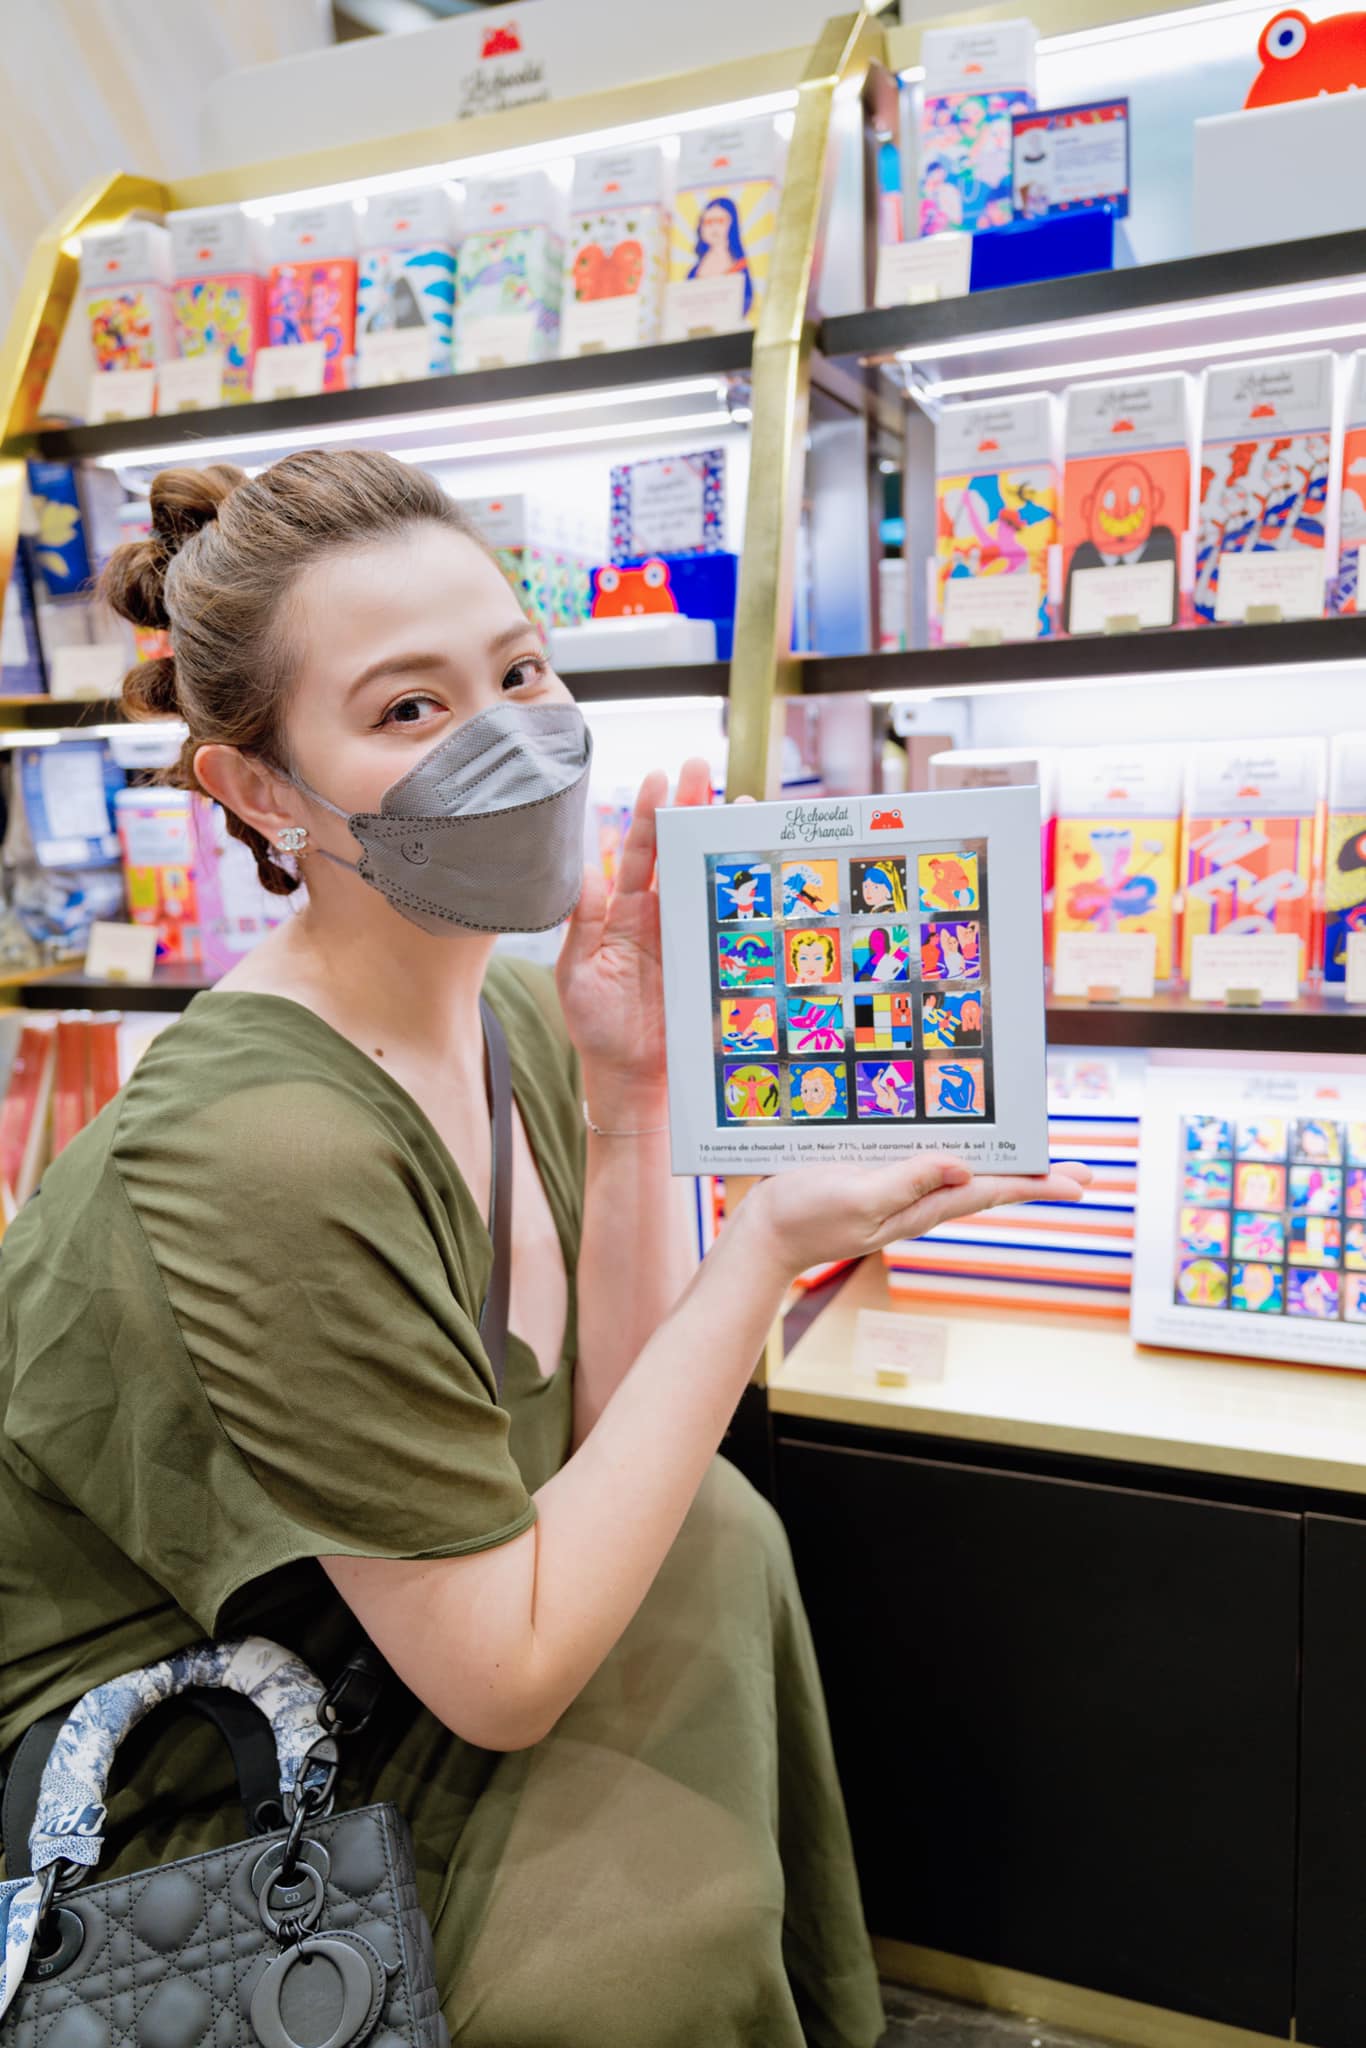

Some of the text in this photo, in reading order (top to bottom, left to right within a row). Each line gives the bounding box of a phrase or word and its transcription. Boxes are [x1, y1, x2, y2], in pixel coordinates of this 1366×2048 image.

[786, 805, 849, 827] Le chocolat
[780, 823, 854, 842] des Français
[699, 1143, 711, 1152] 16
[738, 1142, 749, 1152] de
[751, 1142, 785, 1151] chocolat
[817, 1142, 836, 1151] Noir
[861, 1142, 878, 1151] Lait
[879, 1142, 914, 1151] caramel
[915, 1142, 923, 1150] &
[942, 1141, 961, 1150] Noir
[963, 1141, 971, 1150] &
[973, 1140, 985, 1150] sel
[998, 1141, 1016, 1152] 80g
[284, 1891, 300, 1904] CD
